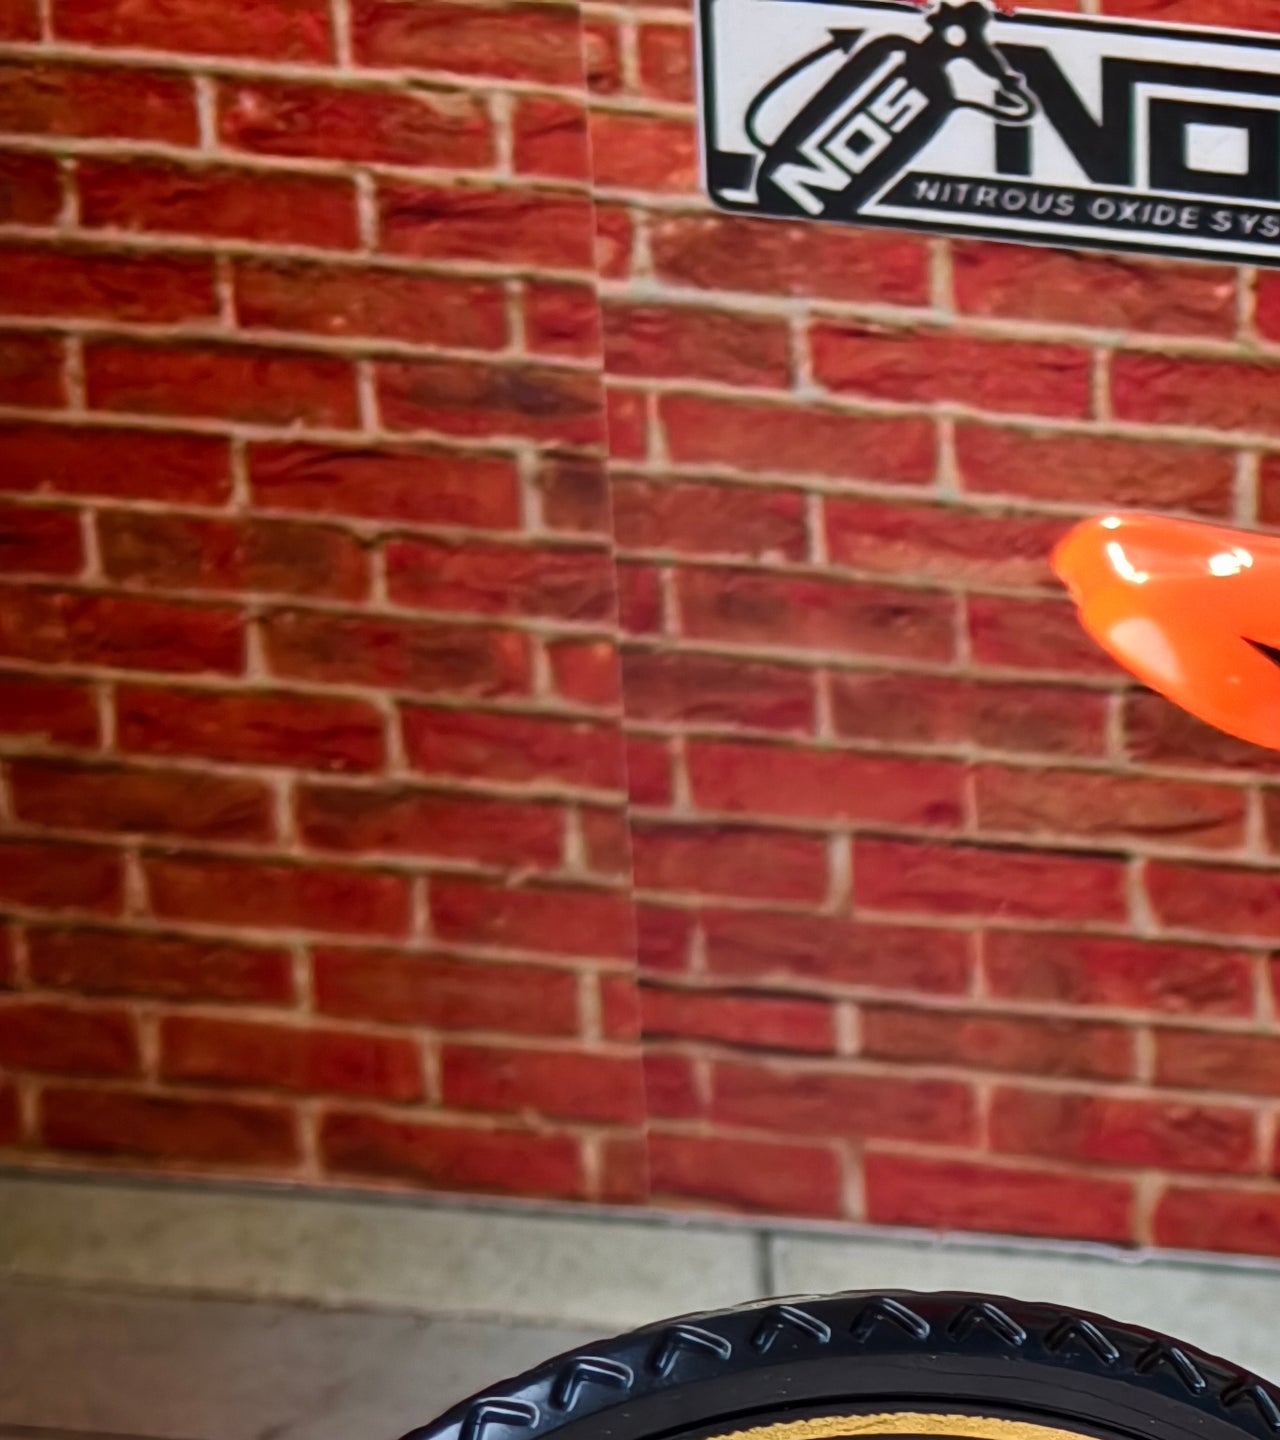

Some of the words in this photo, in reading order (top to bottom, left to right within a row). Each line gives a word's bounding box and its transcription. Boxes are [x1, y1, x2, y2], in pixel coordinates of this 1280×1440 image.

[769, 74, 930, 216] NOS
[913, 179, 1076, 218] NITROUS
[1087, 197, 1201, 231] OXIDE
